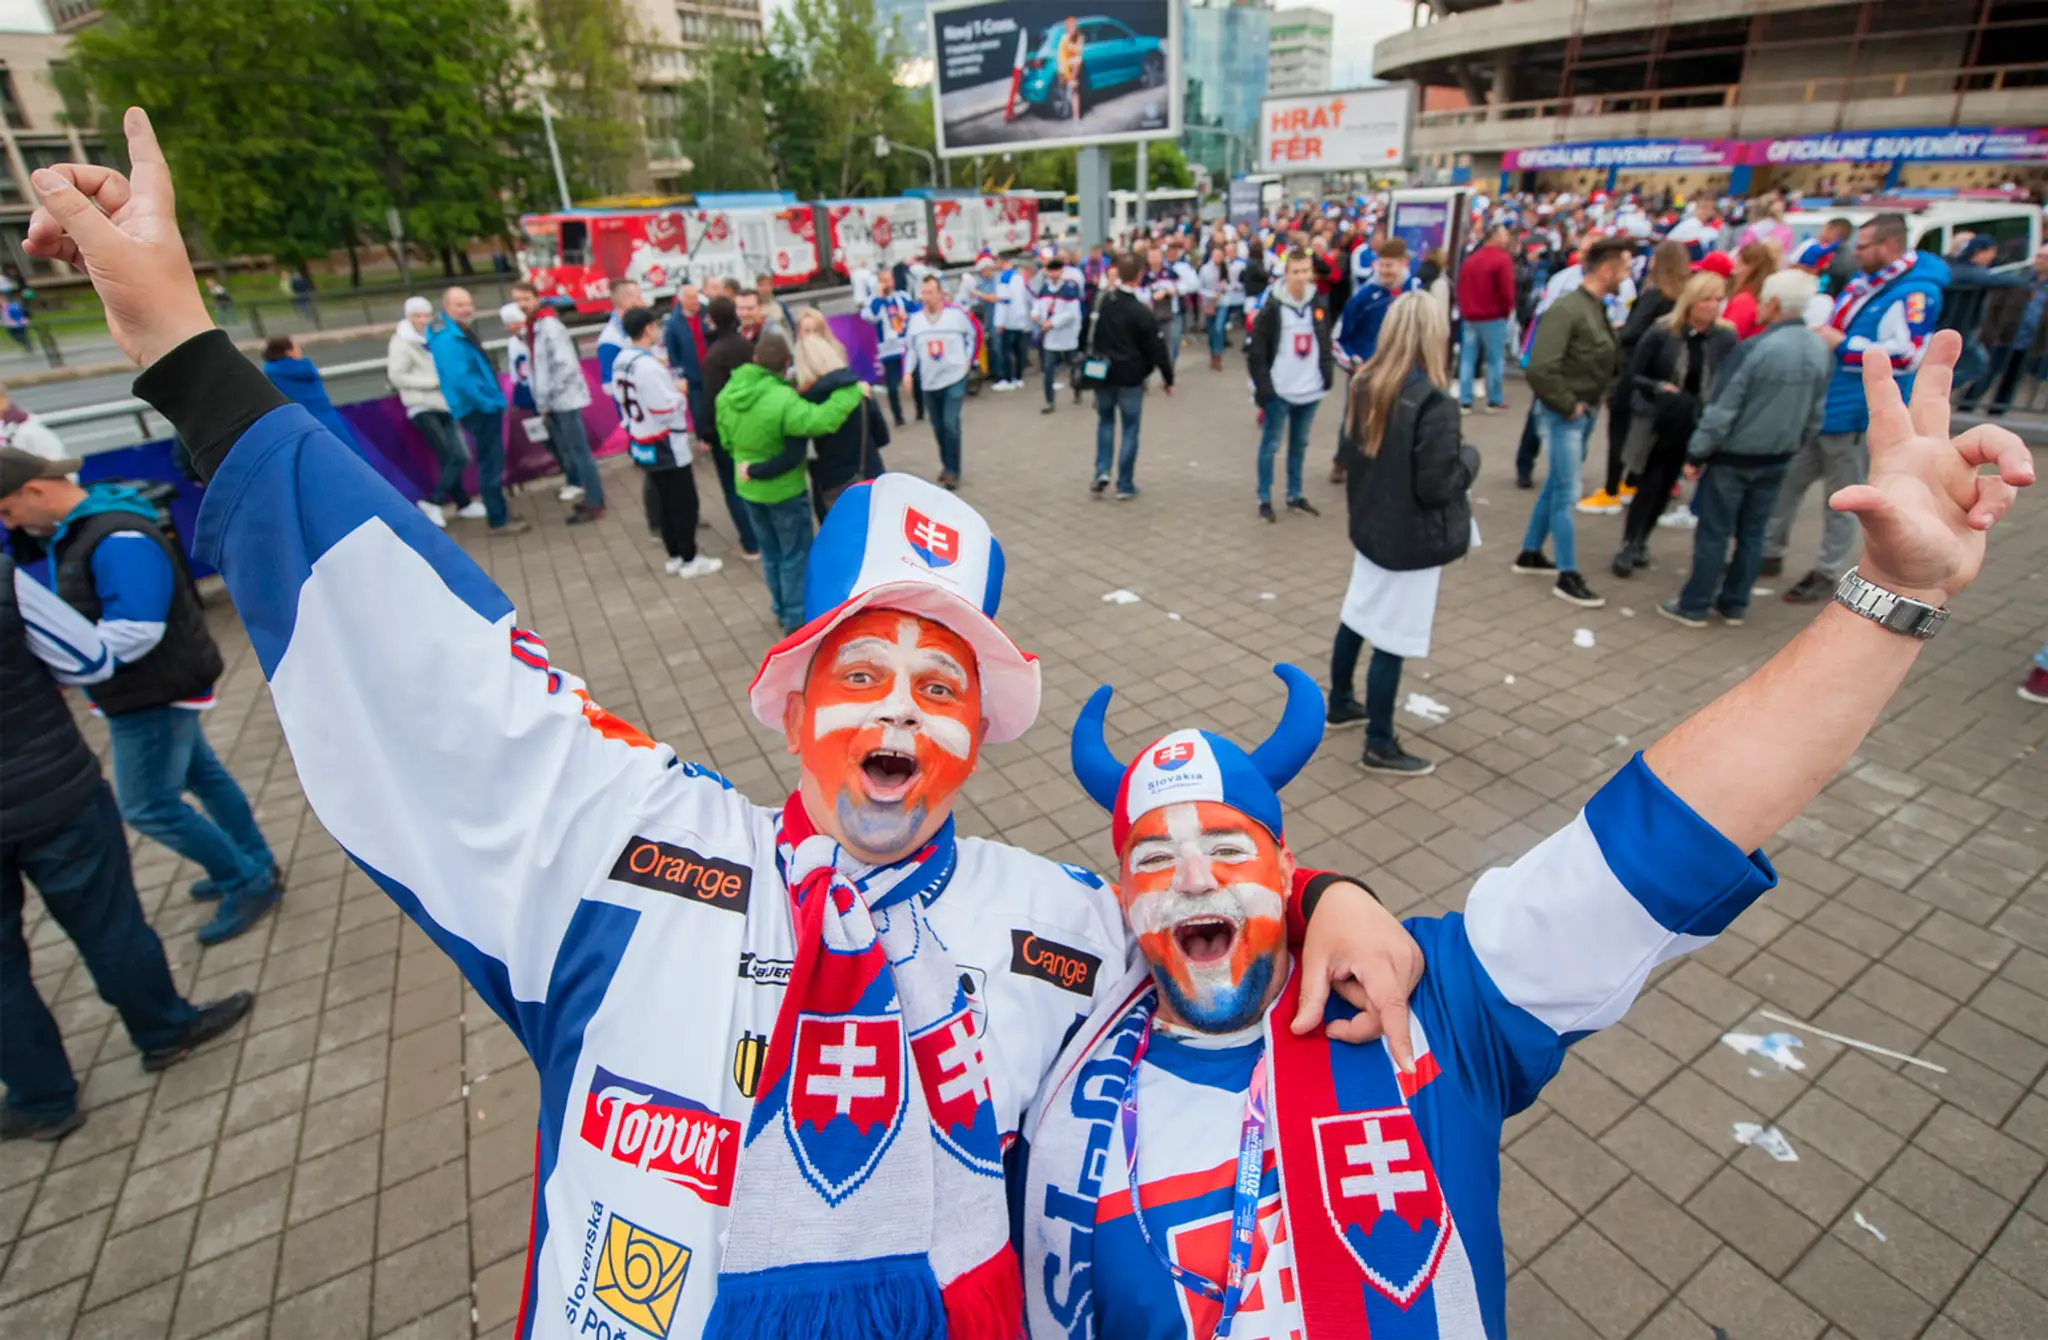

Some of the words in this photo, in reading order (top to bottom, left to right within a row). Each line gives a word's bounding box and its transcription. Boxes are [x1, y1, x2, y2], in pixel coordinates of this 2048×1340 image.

[1147, 772, 1204, 790] Slovakia
[629, 843, 743, 900] Orange
[1022, 935, 1088, 987] Oange
[596, 1085, 732, 1174] Topvar
[1246, 1163, 1260, 1198] 2019
[565, 1200, 604, 1324] slovenská
[580, 1307, 628, 1340] PO
